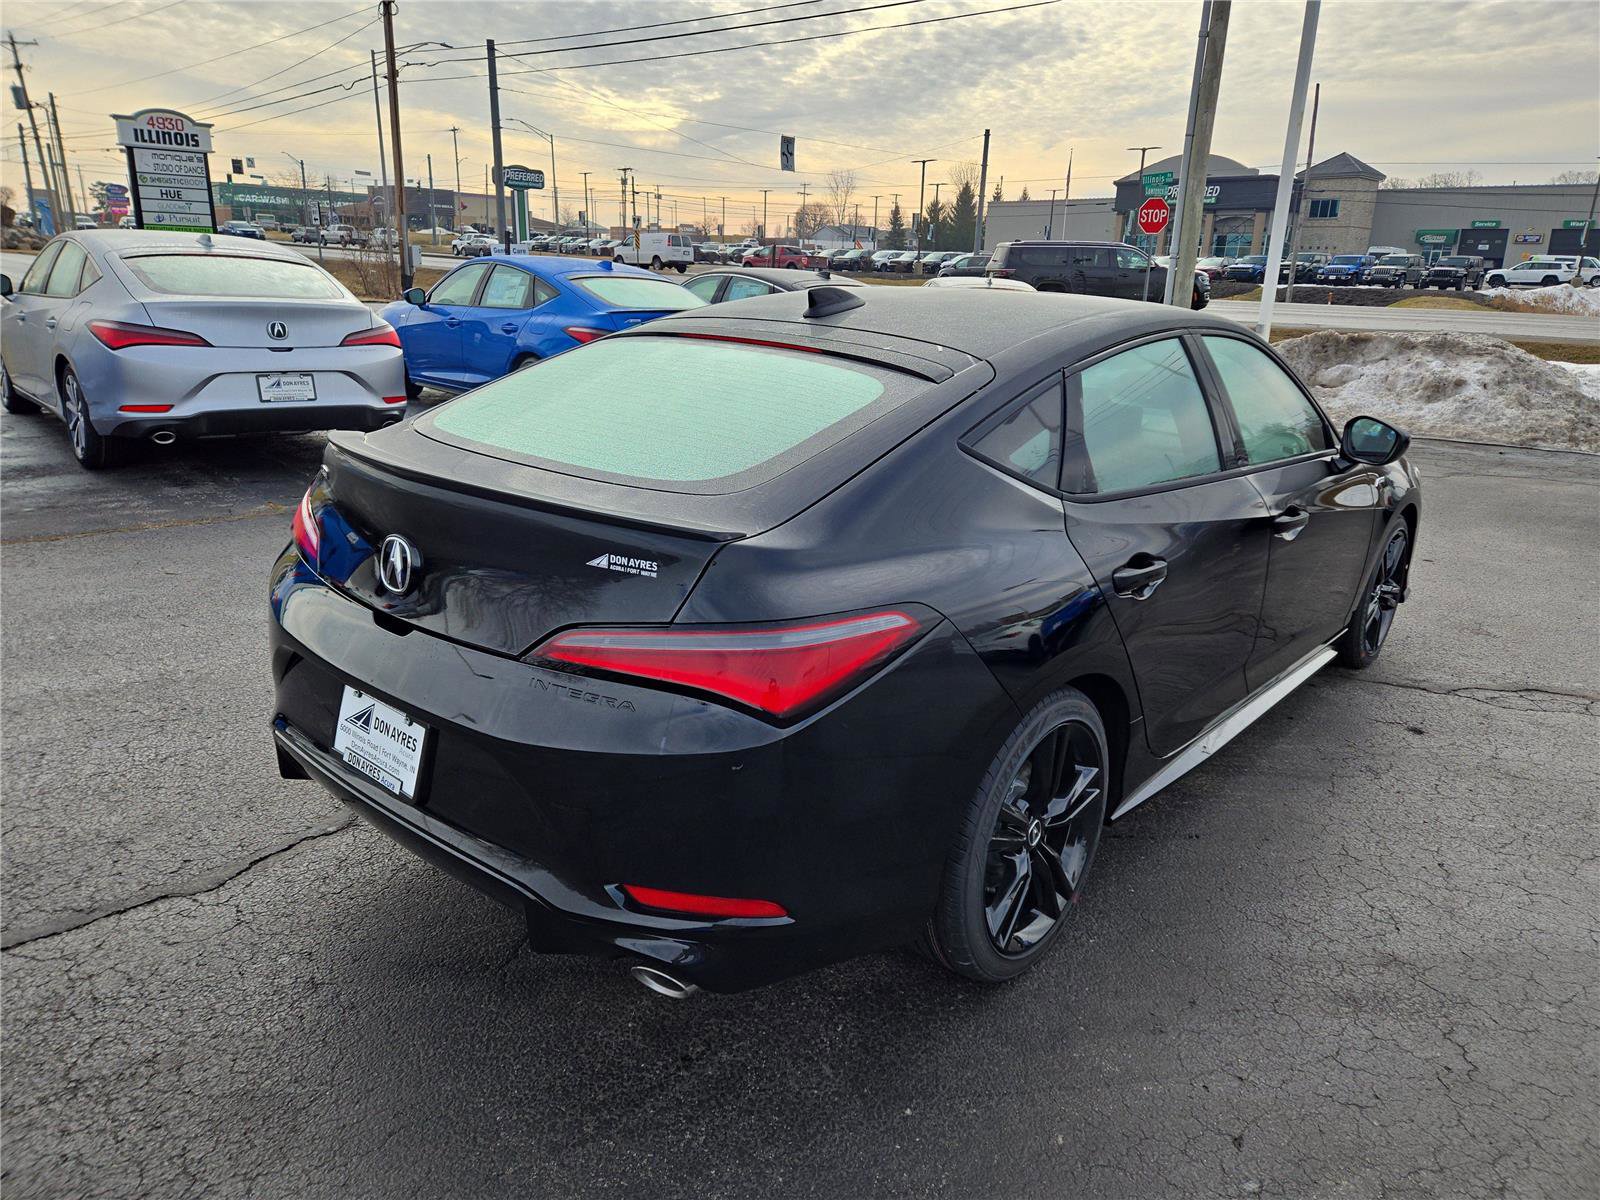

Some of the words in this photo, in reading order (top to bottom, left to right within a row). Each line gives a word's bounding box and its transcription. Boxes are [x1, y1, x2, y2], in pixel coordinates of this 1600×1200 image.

[146, 116, 184, 132] 4930
[133, 128, 200, 147] ILLINOIS
[152, 152, 204, 163] monique's
[153, 163, 173, 172] STUDIO
[175, 164, 183, 173] OF
[184, 165, 205, 175] DANCE
[504, 169, 544, 182] PREFERRED
[1143, 175, 1165, 184] Illinois
[160, 189, 183, 199] HUE
[239, 194, 258, 202] CAR
[169, 214, 200, 224] Pursuit
[1140, 209, 1167, 223] STOP
[610, 554, 628, 566] DON
[629, 558, 658, 571] AYRES
[528, 678, 636, 713] INTEGRA
[374, 717, 391, 738] DON
[390, 727, 418, 752] AYRES
[340, 724, 352, 735] 5000
[352, 729, 366, 744] Illinois
[366, 737, 378, 752] Road
[382, 746, 392, 758] Fort
[409, 764, 416, 774] IN
[351, 740, 400, 776] DonAyresAcura.com
[348, 752, 360, 768] DON
[360, 760, 380, 780] AYRES
[380, 776, 396, 790] Acura
